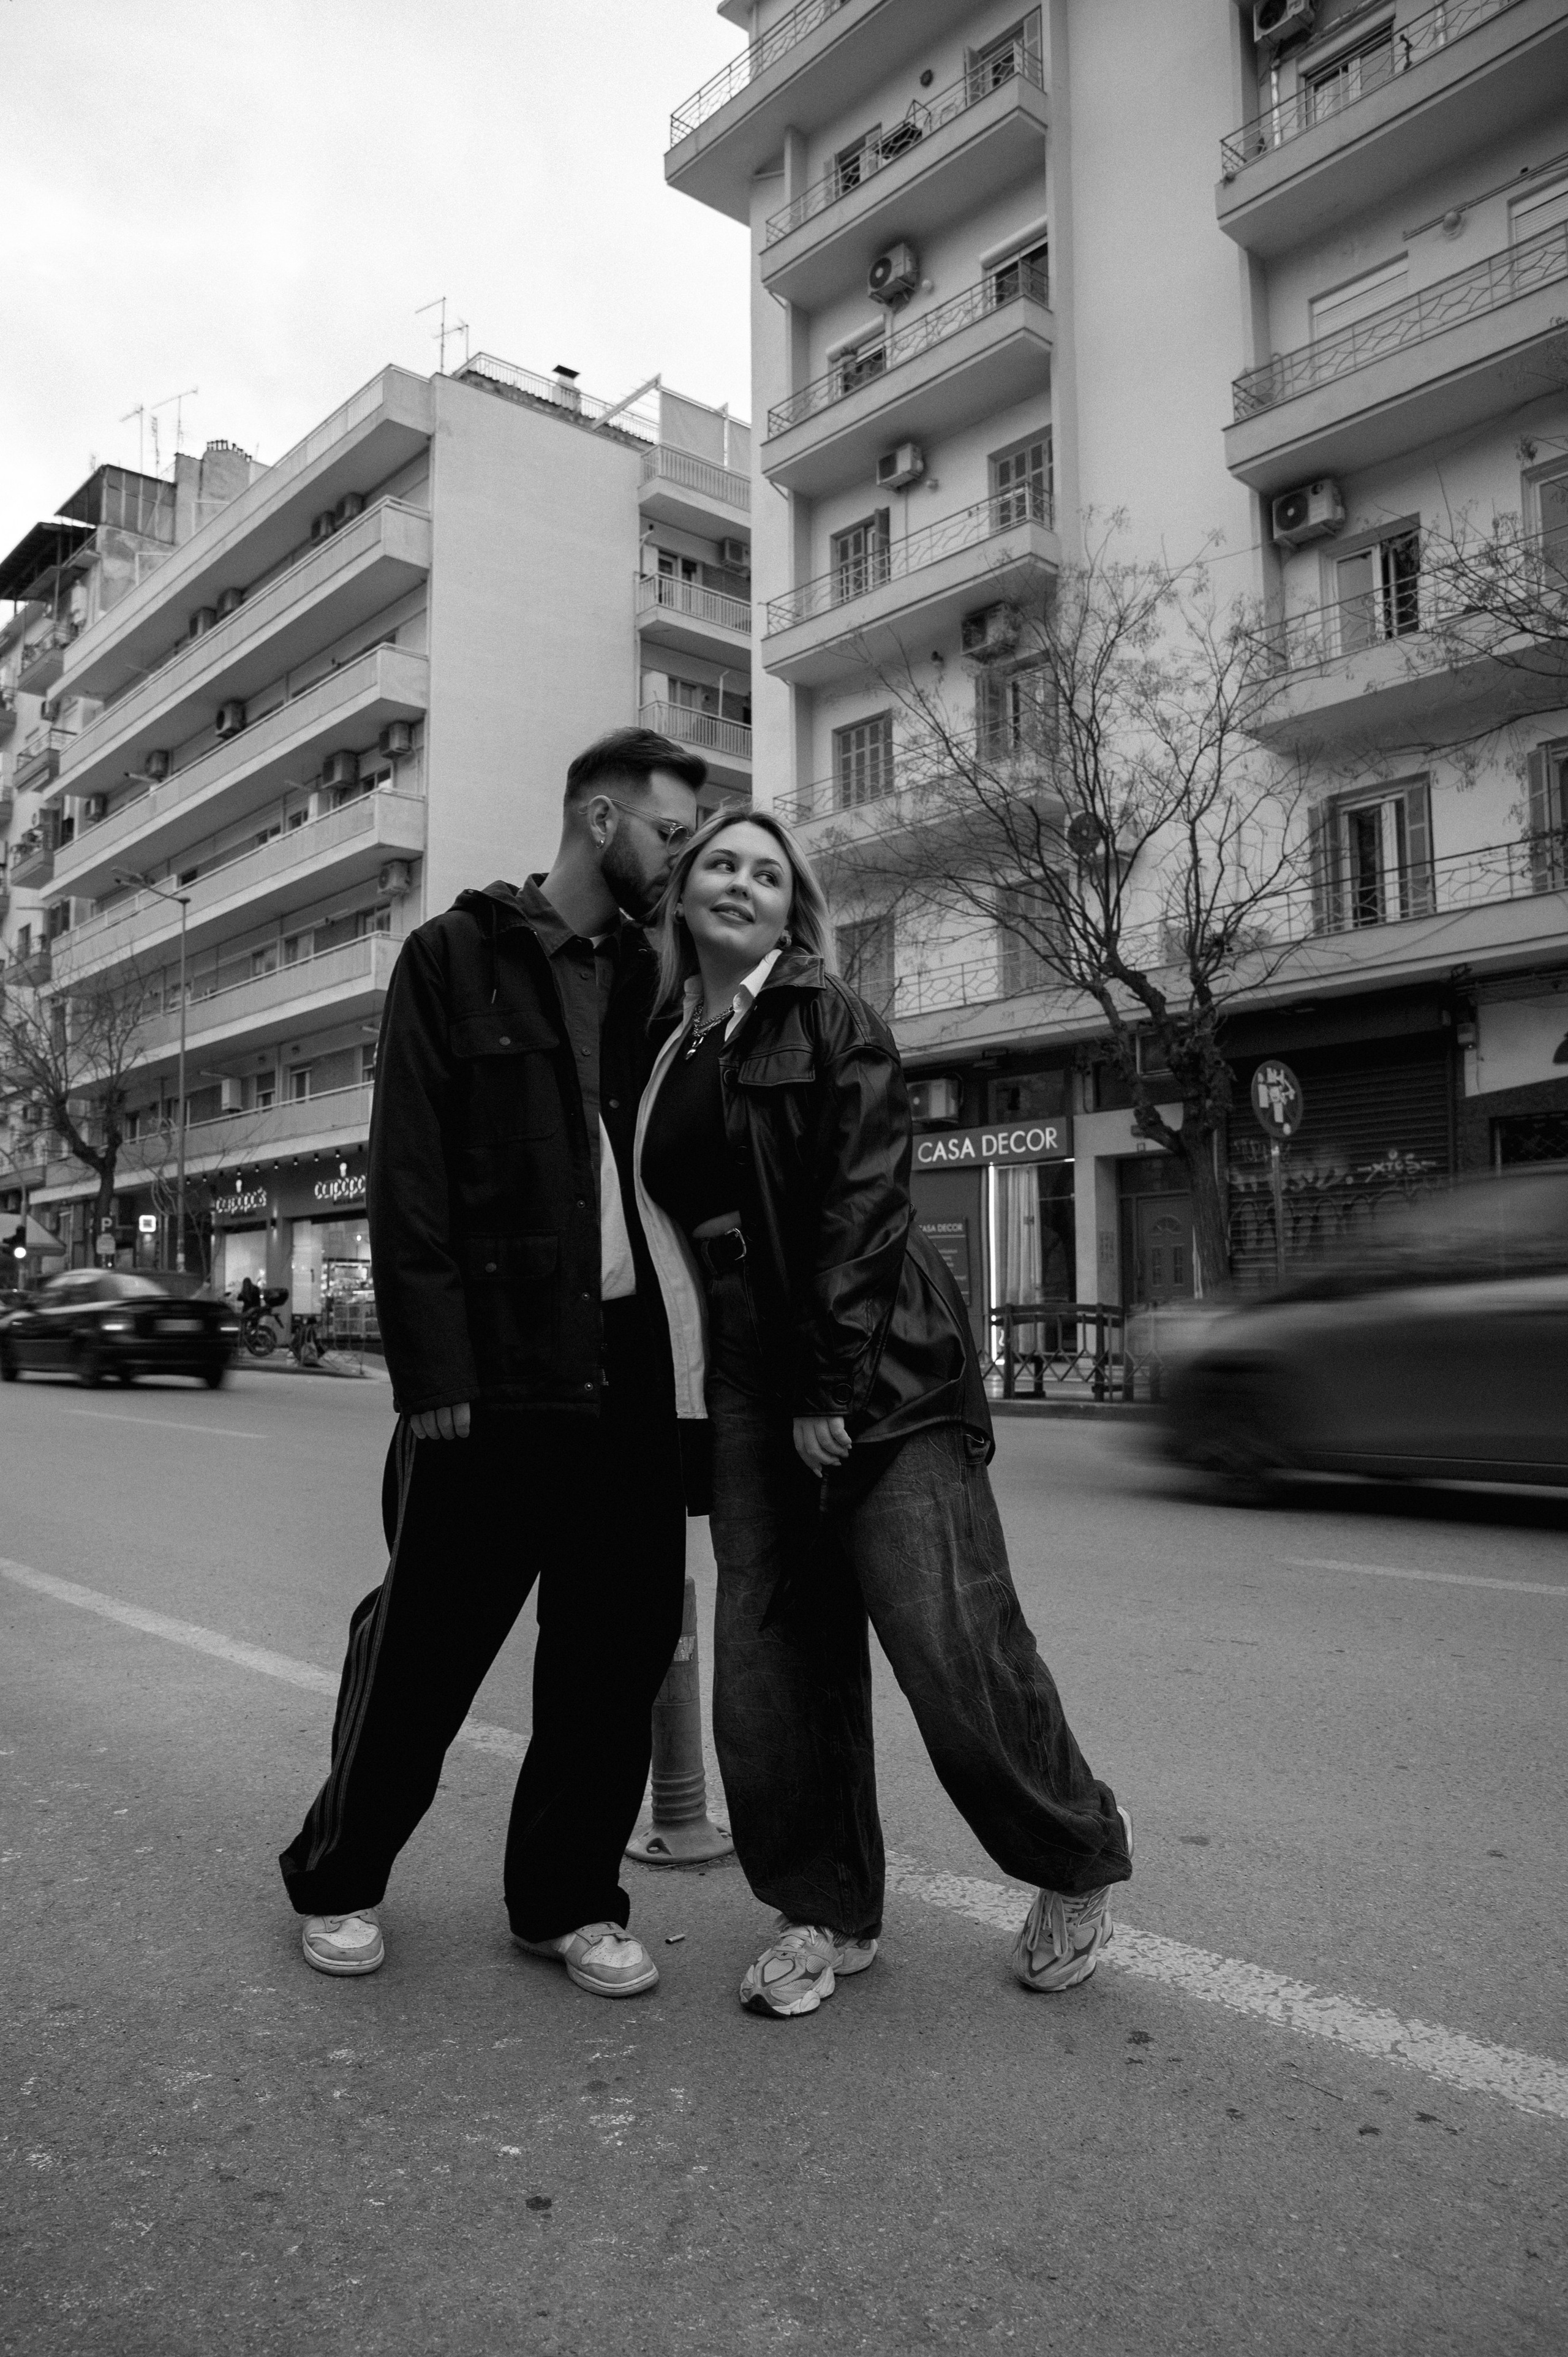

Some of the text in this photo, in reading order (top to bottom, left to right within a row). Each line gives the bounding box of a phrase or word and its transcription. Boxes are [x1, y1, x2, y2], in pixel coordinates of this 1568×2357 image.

[918, 1127, 1058, 1163] CASA DECOR
[101, 1217, 112, 1232] P
[937, 1223, 963, 1232] DECOR
